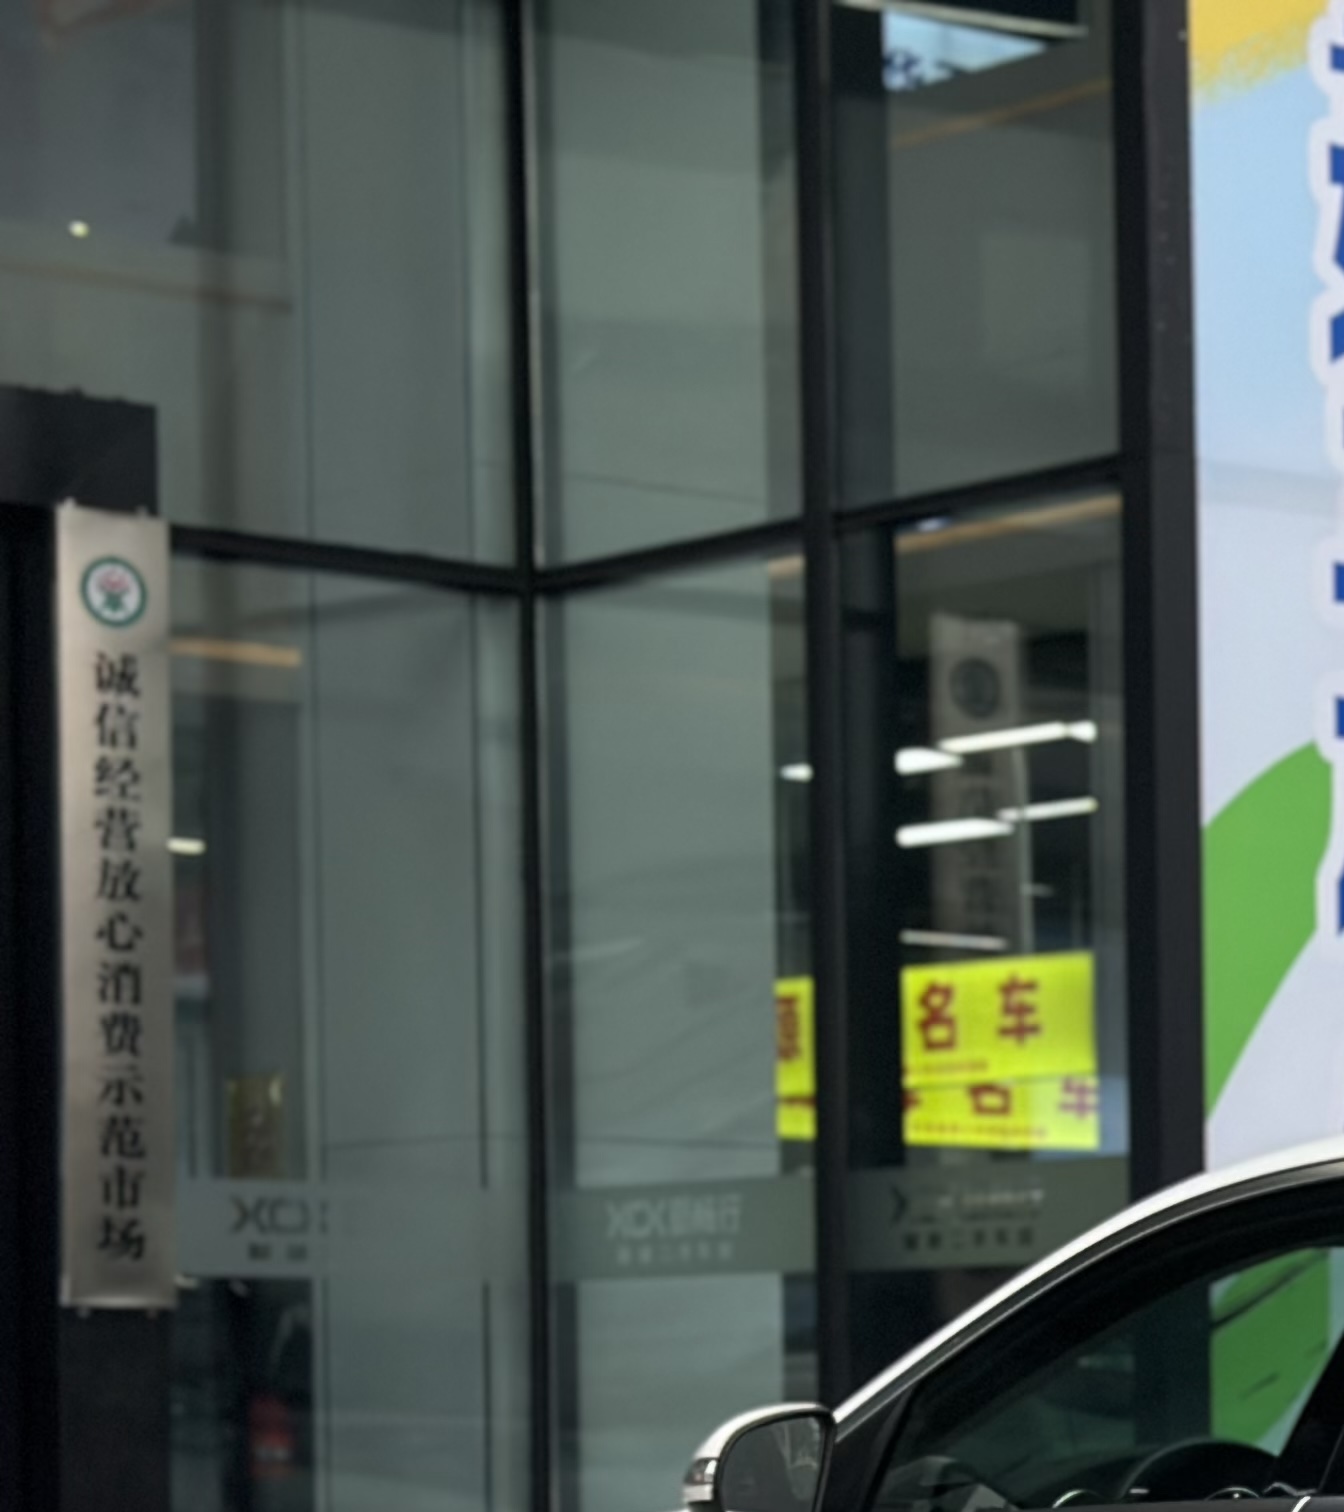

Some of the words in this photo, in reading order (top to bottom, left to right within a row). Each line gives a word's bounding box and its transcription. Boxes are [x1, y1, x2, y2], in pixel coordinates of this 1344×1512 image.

[93, 648, 148, 1265] 诚信经营放心消费示范市场
